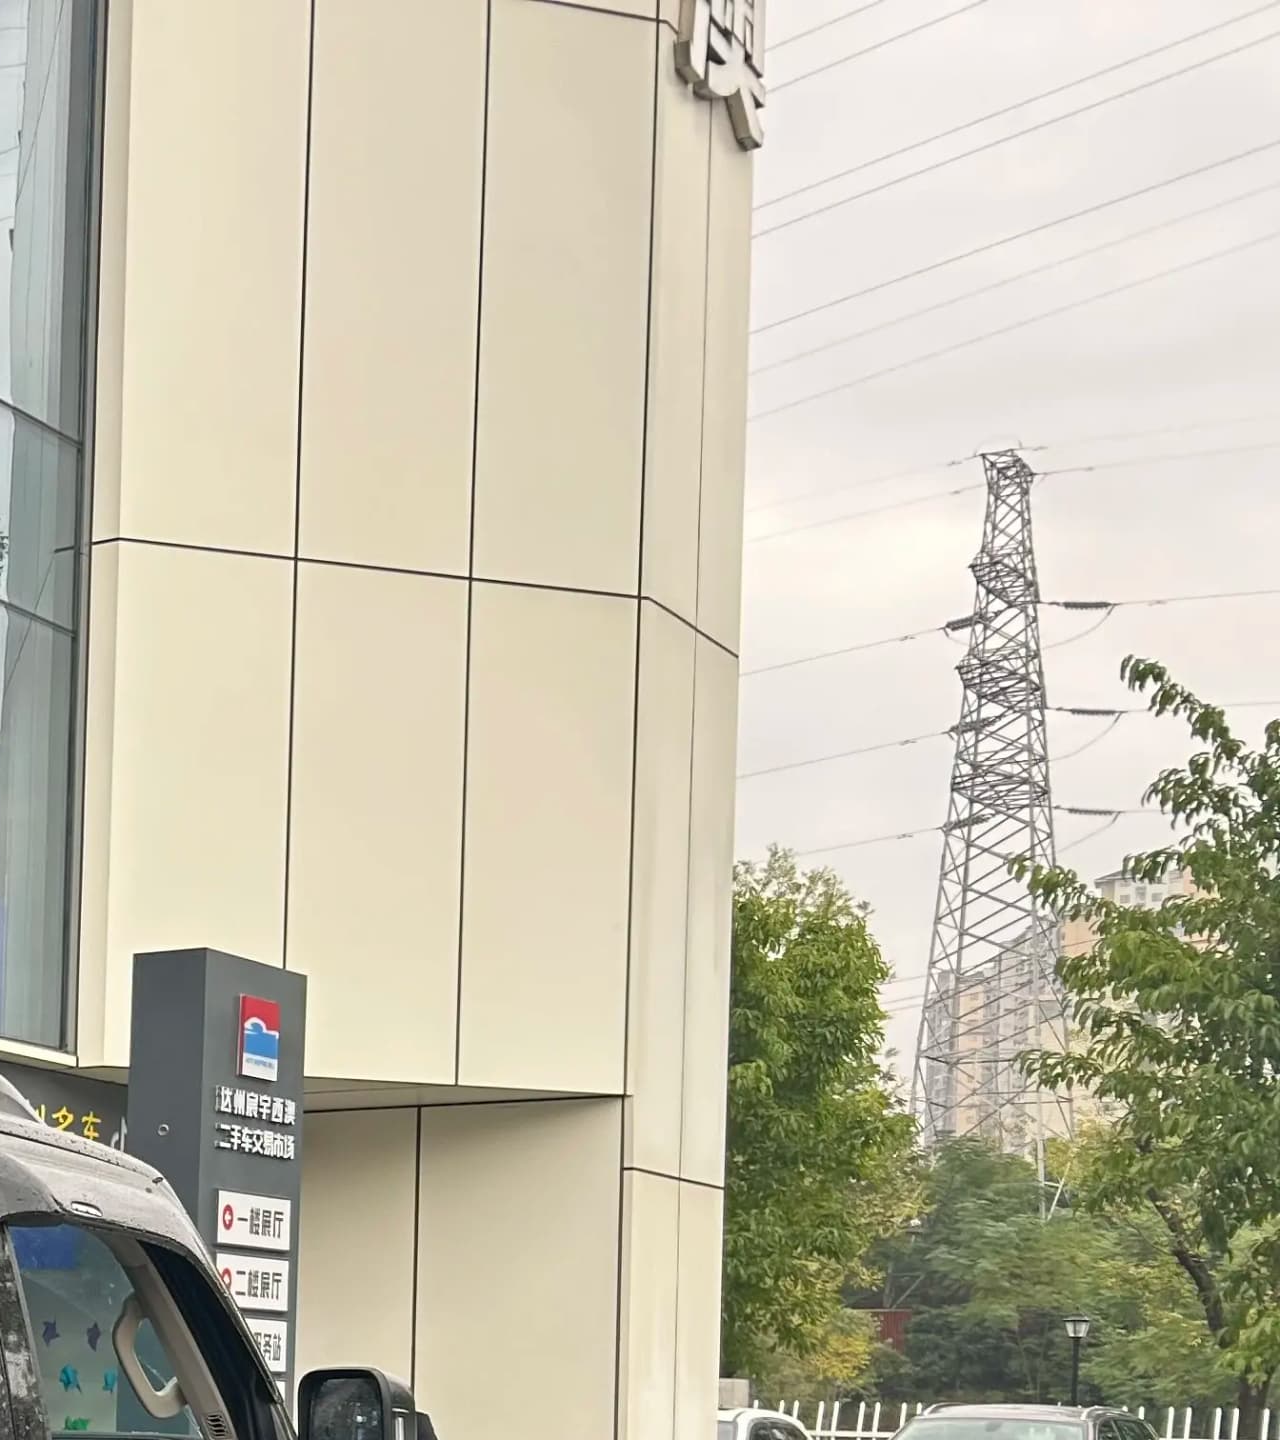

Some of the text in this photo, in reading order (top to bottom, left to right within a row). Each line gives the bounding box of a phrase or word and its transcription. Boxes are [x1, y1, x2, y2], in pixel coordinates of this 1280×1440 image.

[215, 1122, 295, 1160] 二手车交易市场
[237, 1207, 284, 1239] 一楼展厅
[235, 1269, 282, 1300] 二楼展厅
